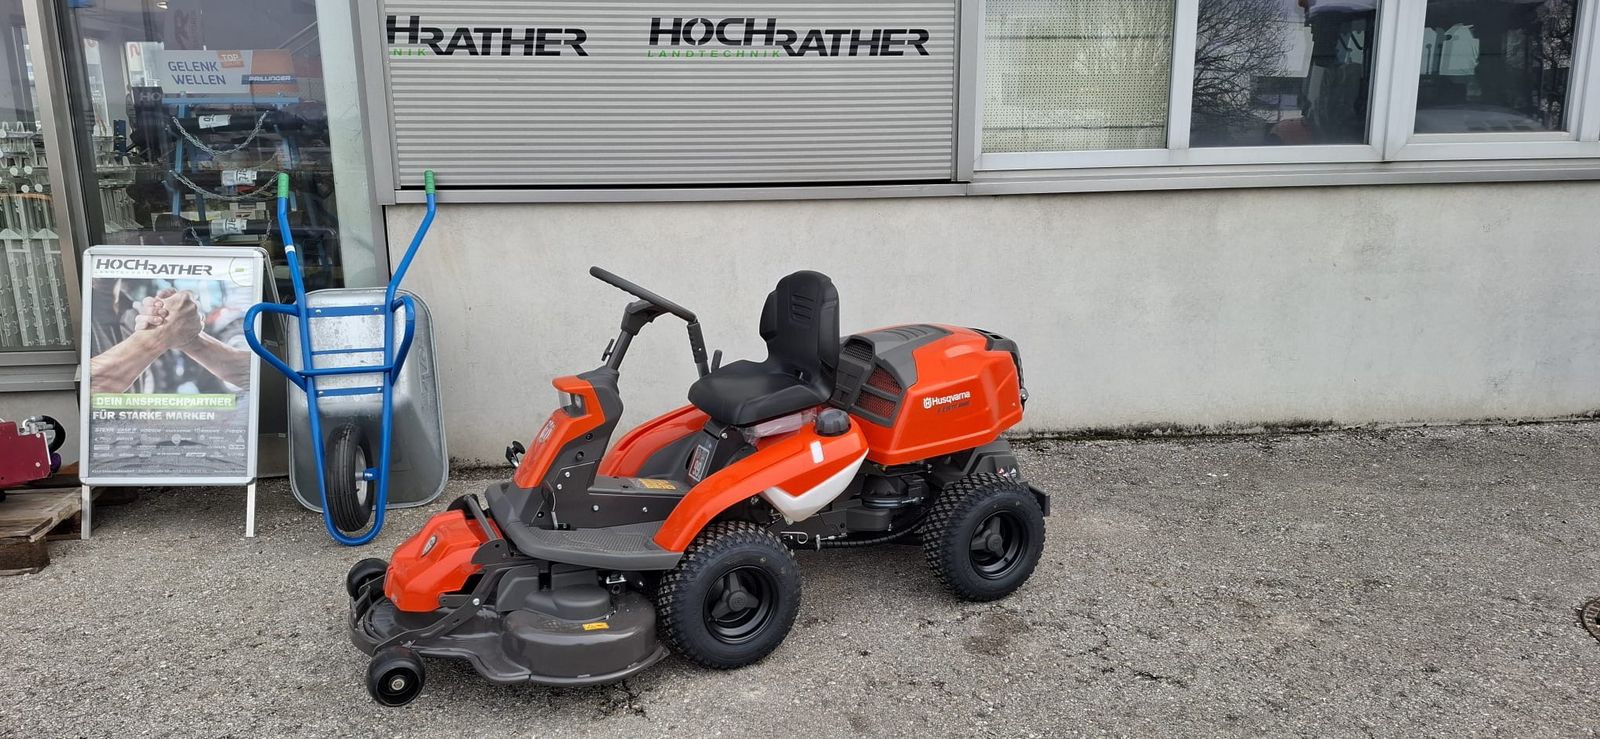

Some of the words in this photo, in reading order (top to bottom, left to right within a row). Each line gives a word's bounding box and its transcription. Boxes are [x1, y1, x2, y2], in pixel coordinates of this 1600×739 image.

[649, 17, 930, 57] HOCHRATHER
[221, 53, 240, 62] TOP
[647, 49, 782, 58] LANDTECHNIK
[167, 61, 219, 72] GELENK
[171, 74, 226, 85] WELLEN
[95, 258, 213, 276] HOCHRATHER
[96, 397, 122, 406] DEIN
[125, 397, 233, 407] ANSPRECHPARTNER
[932, 391, 971, 406] Husqvarna
[92, 410, 115, 420] FÜR
[119, 411, 163, 421] STARKE
[166, 411, 215, 420] MARKEN
